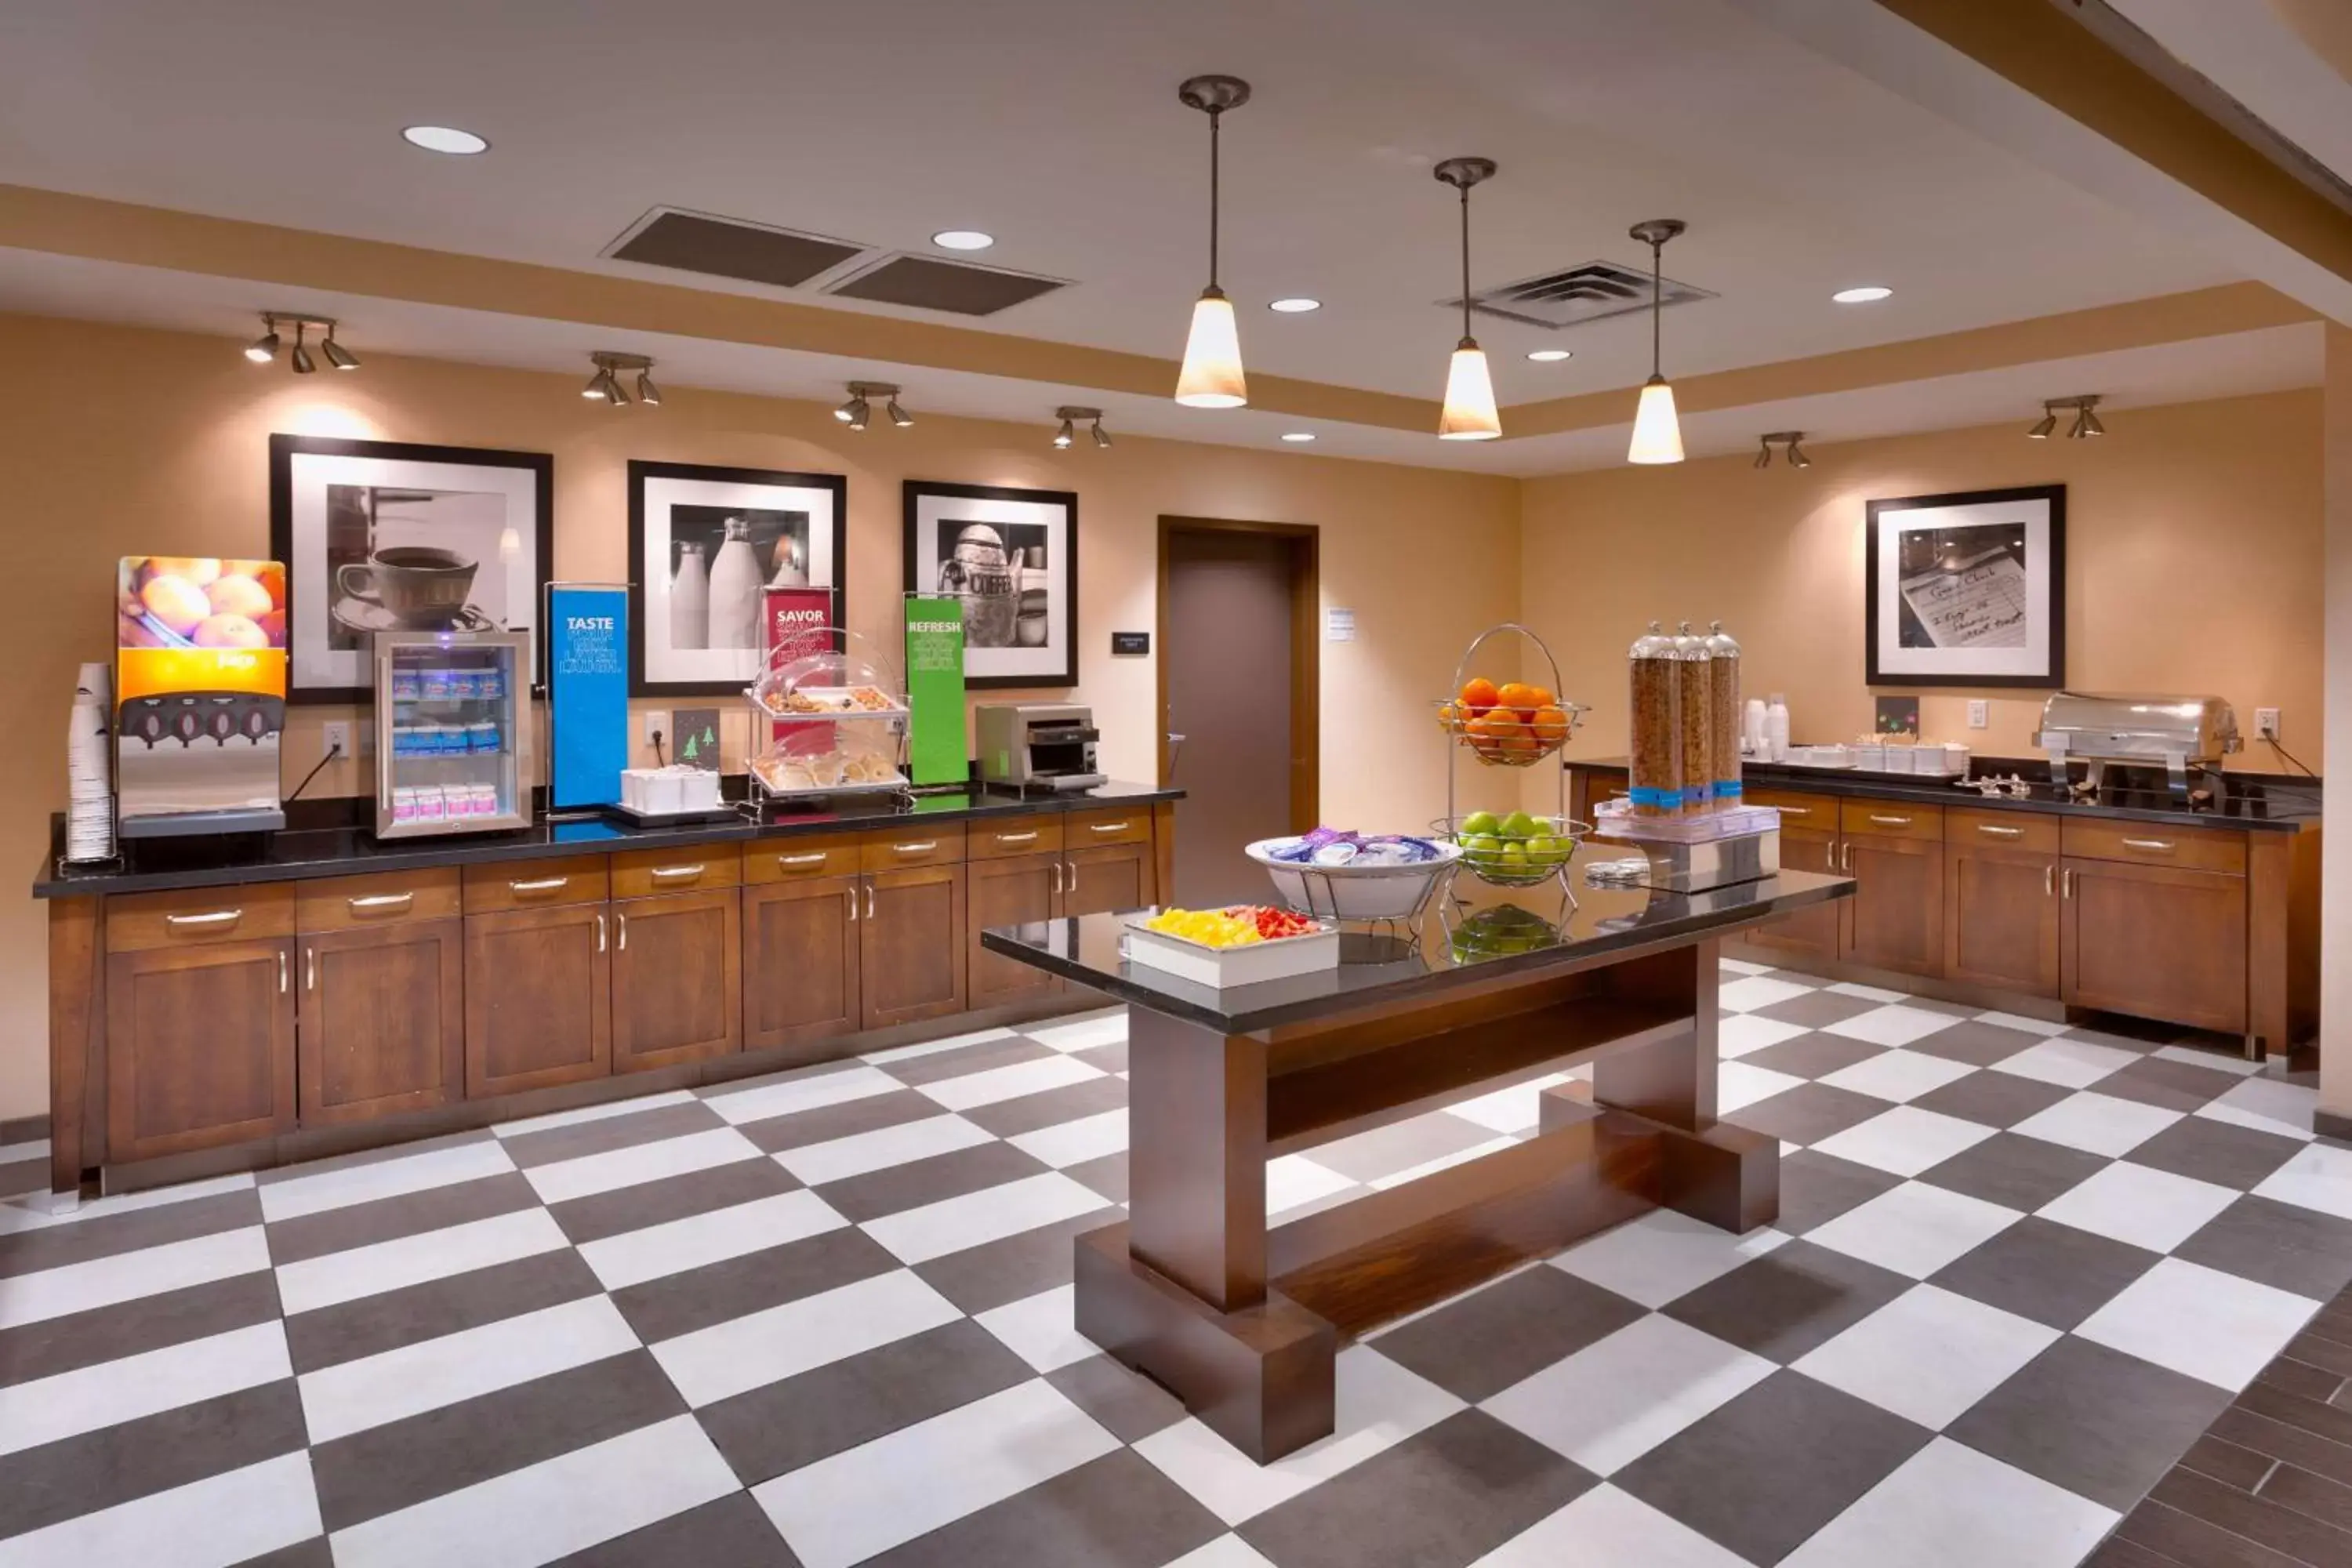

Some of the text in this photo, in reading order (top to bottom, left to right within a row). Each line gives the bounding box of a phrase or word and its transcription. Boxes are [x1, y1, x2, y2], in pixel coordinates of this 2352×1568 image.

[777, 610, 825, 622] SAVOR
[567, 616, 615, 630] TASTE
[909, 621, 960, 633] REFRESH
